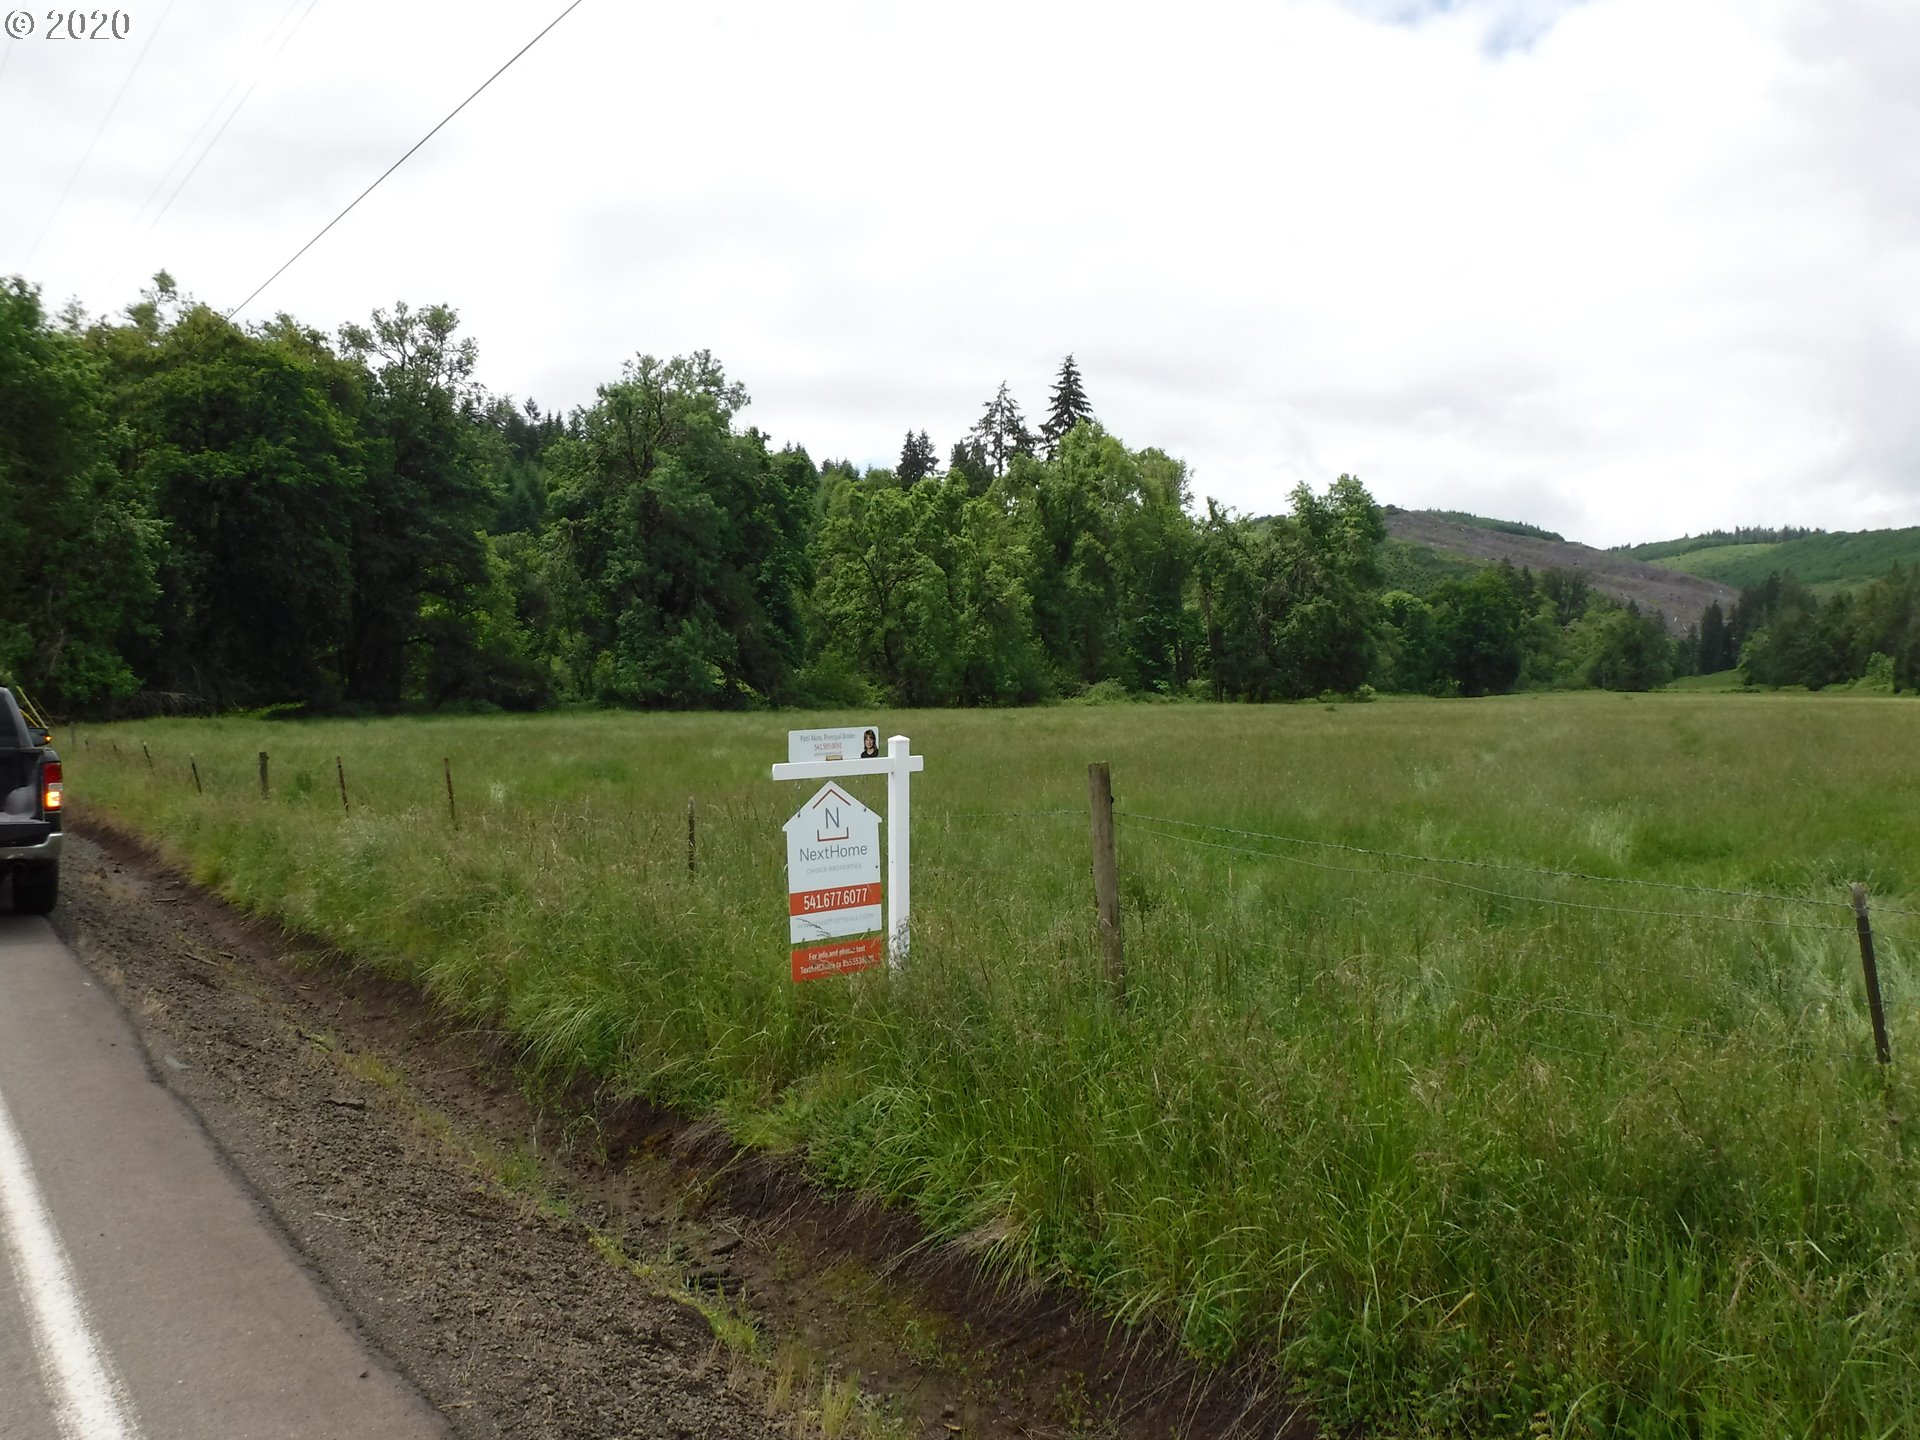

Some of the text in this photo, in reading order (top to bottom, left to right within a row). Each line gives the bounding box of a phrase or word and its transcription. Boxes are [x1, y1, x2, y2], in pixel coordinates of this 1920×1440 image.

[825, 807, 840, 829] N
[799, 844, 868, 862] NextHome
[806, 862, 863, 875] CHOICE PROPERTIES
[803, 888, 868, 911] 541.677.6077
[808, 952, 818, 961] For
